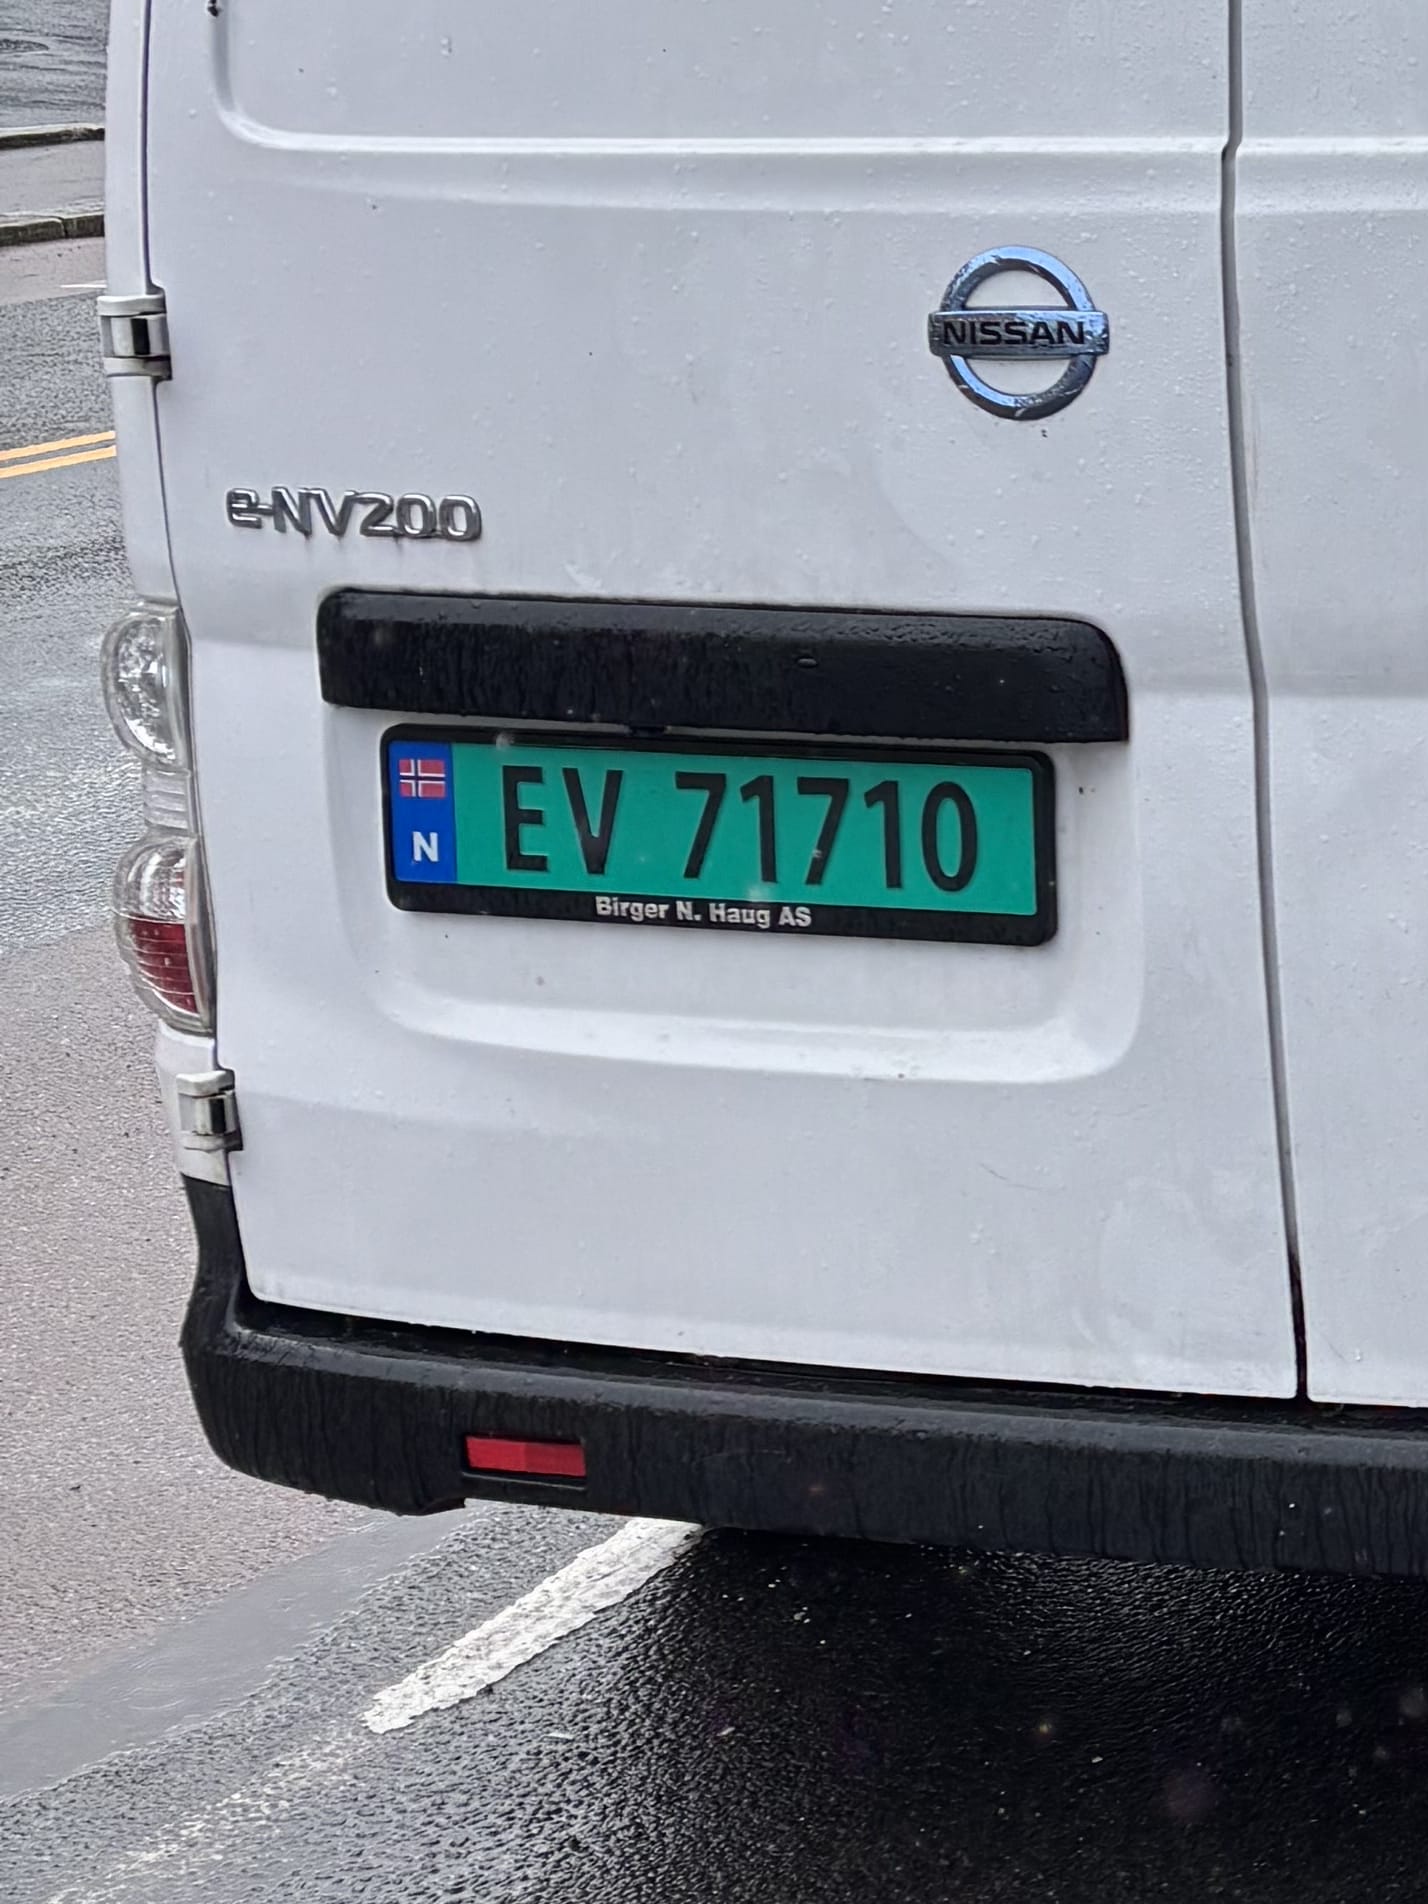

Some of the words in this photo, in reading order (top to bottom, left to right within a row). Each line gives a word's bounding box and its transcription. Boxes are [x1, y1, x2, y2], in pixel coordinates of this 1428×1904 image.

[943, 321, 1085, 346] NISSAN
[227, 486, 482, 541] e-NV200
[501, 764, 623, 876] EV
[675, 771, 978, 894] 71710
[413, 831, 438, 863] N
[595, 895, 669, 922] Birger
[676, 900, 702, 921] N.
[709, 903, 770, 929] Haug
[778, 906, 812, 927] AS
